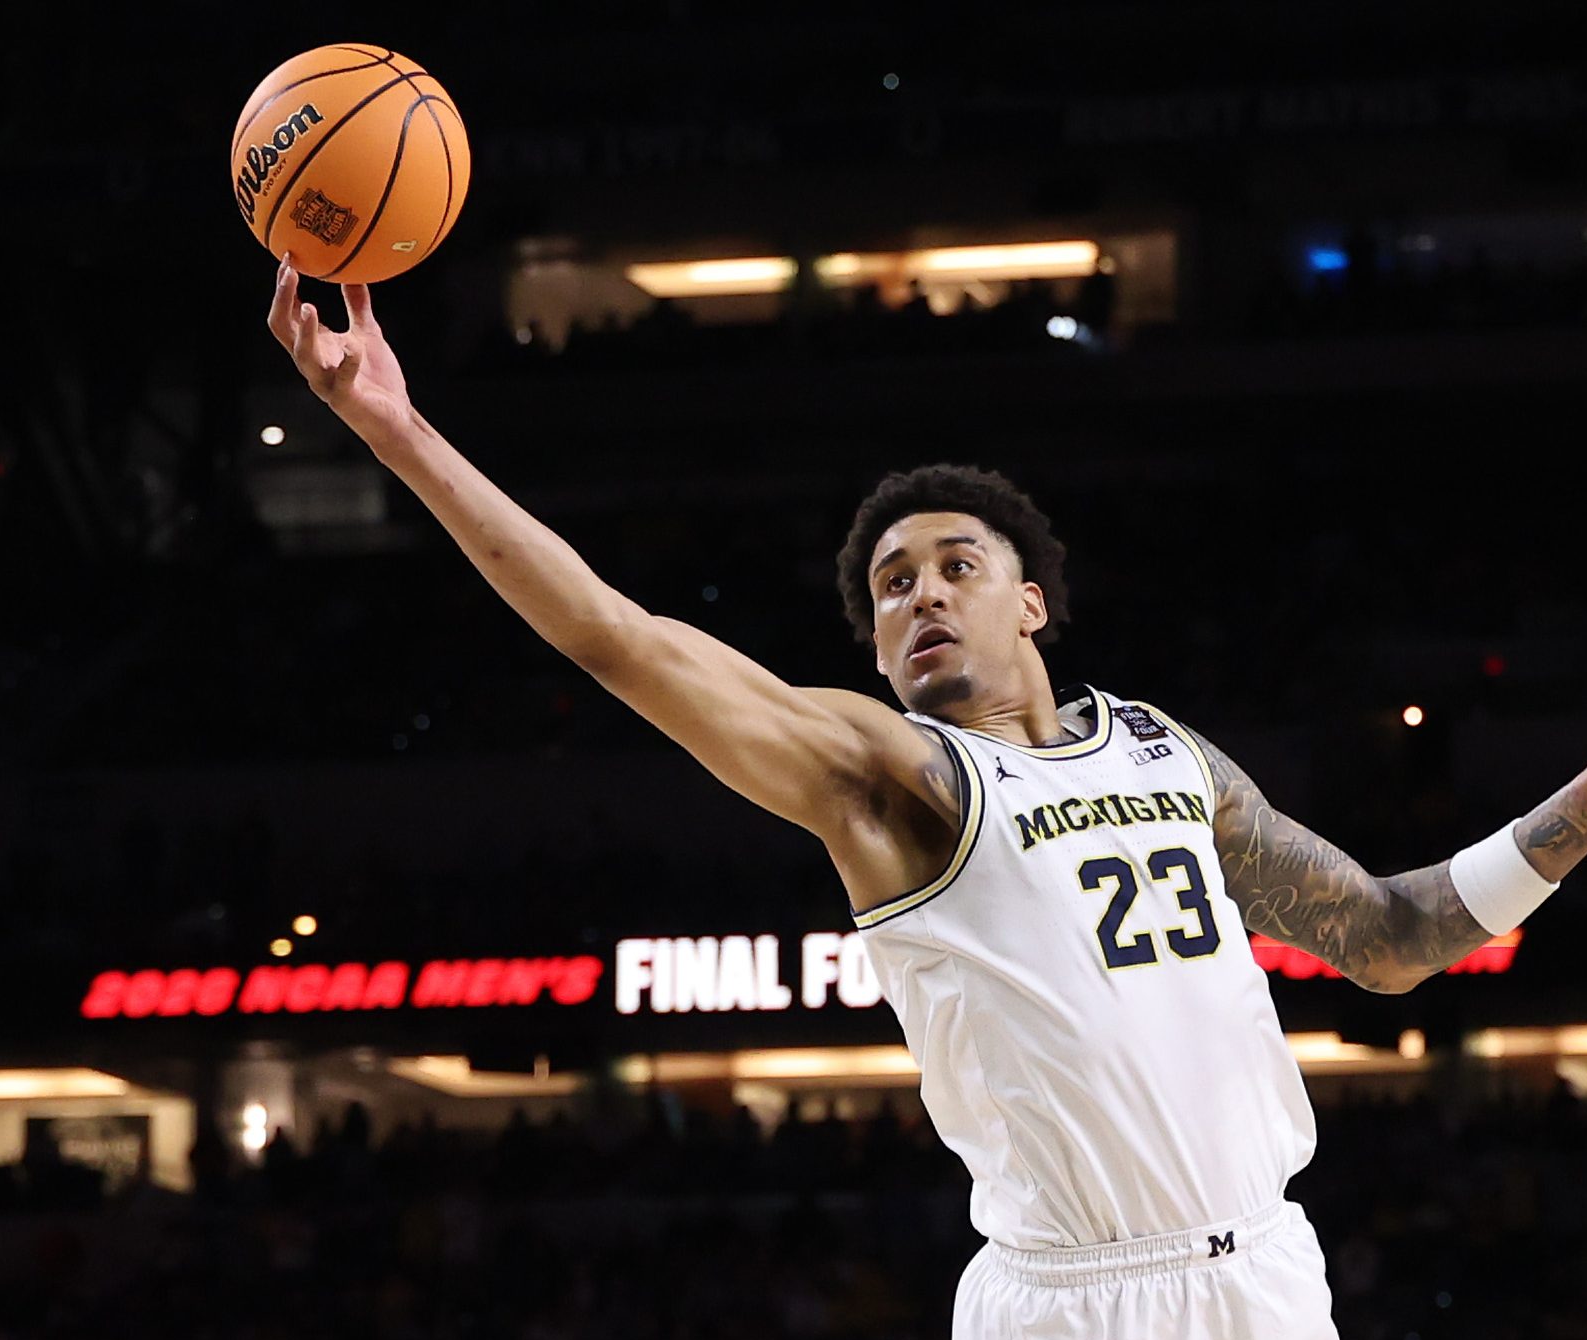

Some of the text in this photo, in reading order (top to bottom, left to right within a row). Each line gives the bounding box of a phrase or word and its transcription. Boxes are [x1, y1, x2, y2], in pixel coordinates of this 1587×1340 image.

[1014, 792, 1213, 850] MICHIGAN
[1076, 846, 1222, 971] 23
[615, 935, 792, 1014] FINAL
[801, 932, 886, 1009] FO
[1207, 1230, 1235, 1258] M
